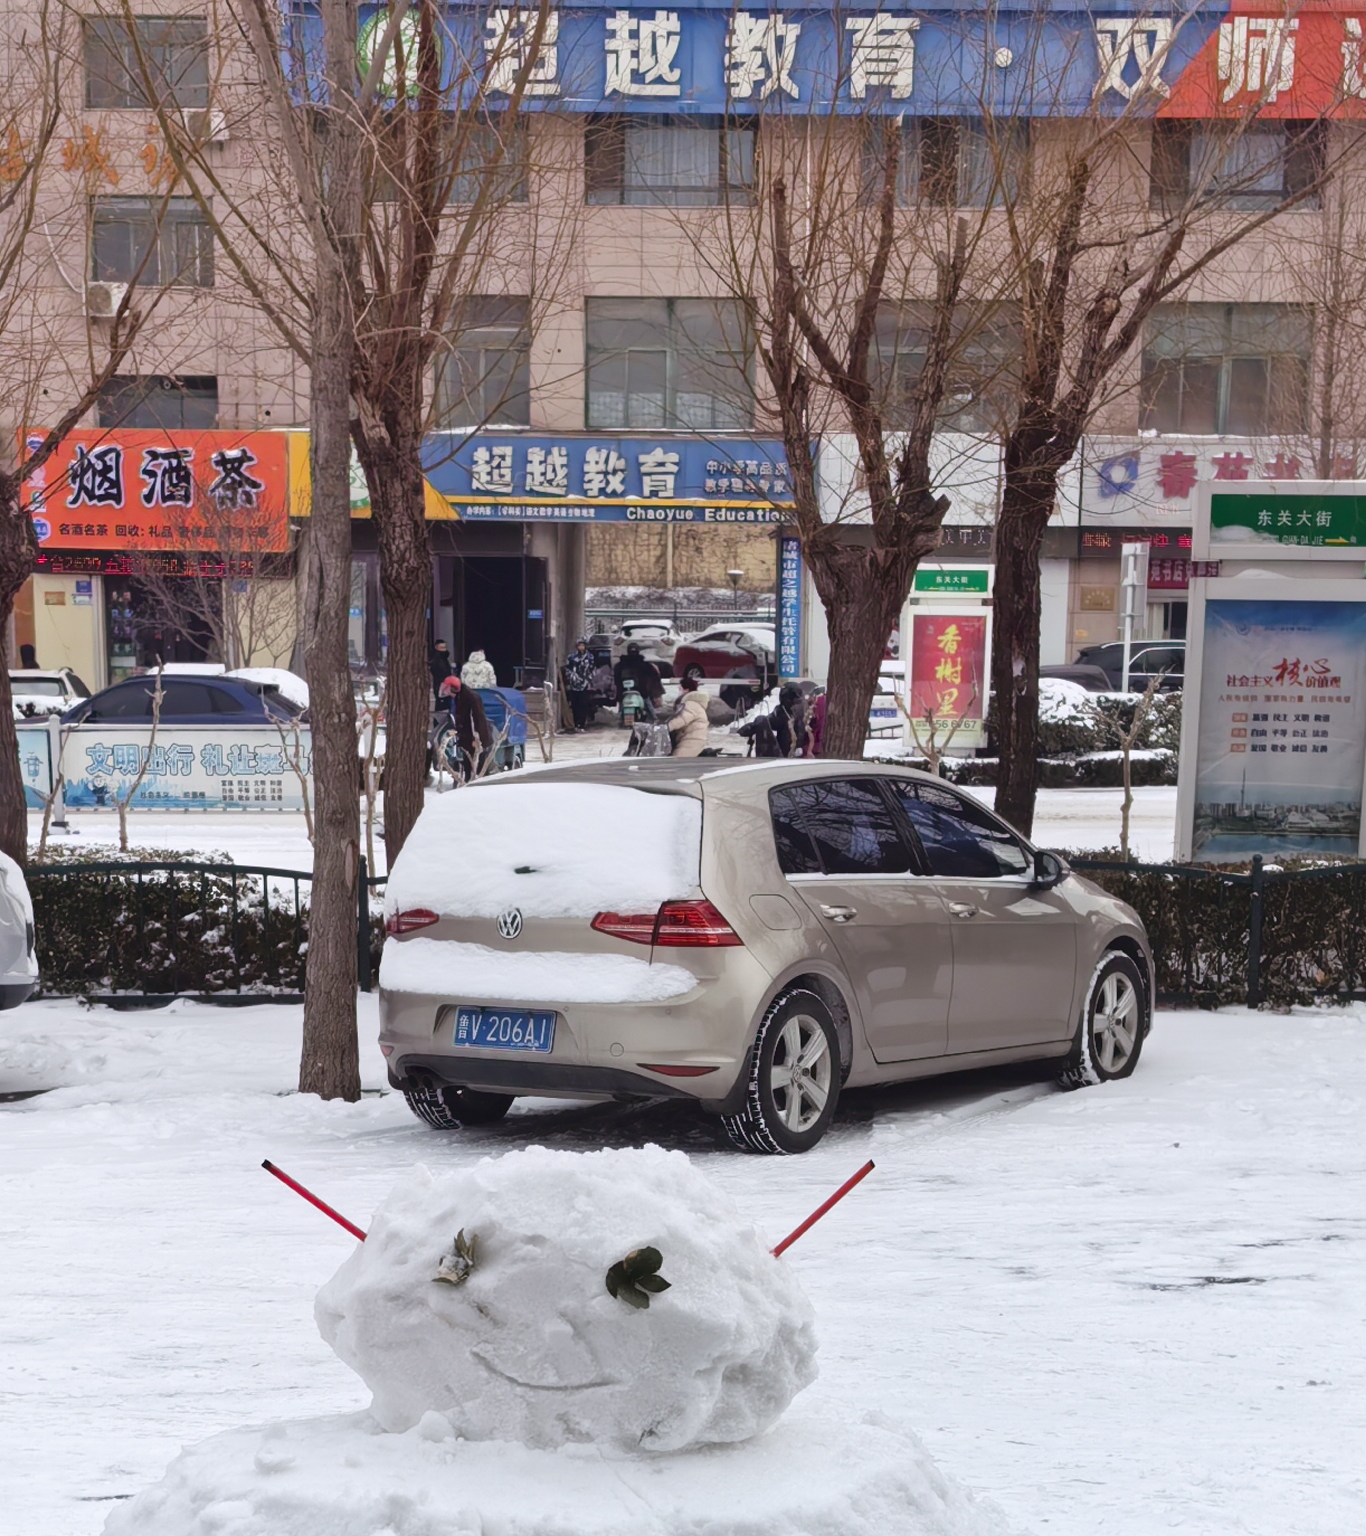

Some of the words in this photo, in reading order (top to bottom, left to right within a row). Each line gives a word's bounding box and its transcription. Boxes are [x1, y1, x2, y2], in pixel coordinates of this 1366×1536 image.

[66, 444, 265, 510] 烟酒茶
[472, 445, 681, 497] 超越教育
[627, 508, 693, 521] Chaoyue
[1257, 509, 1333, 527] 东关大街
[59, 523, 108, 536] 名酒名茶
[936, 575, 968, 584] 东关大街
[86, 743, 194, 776] 文明出行
[201, 744, 313, 776] 礼让斑马
